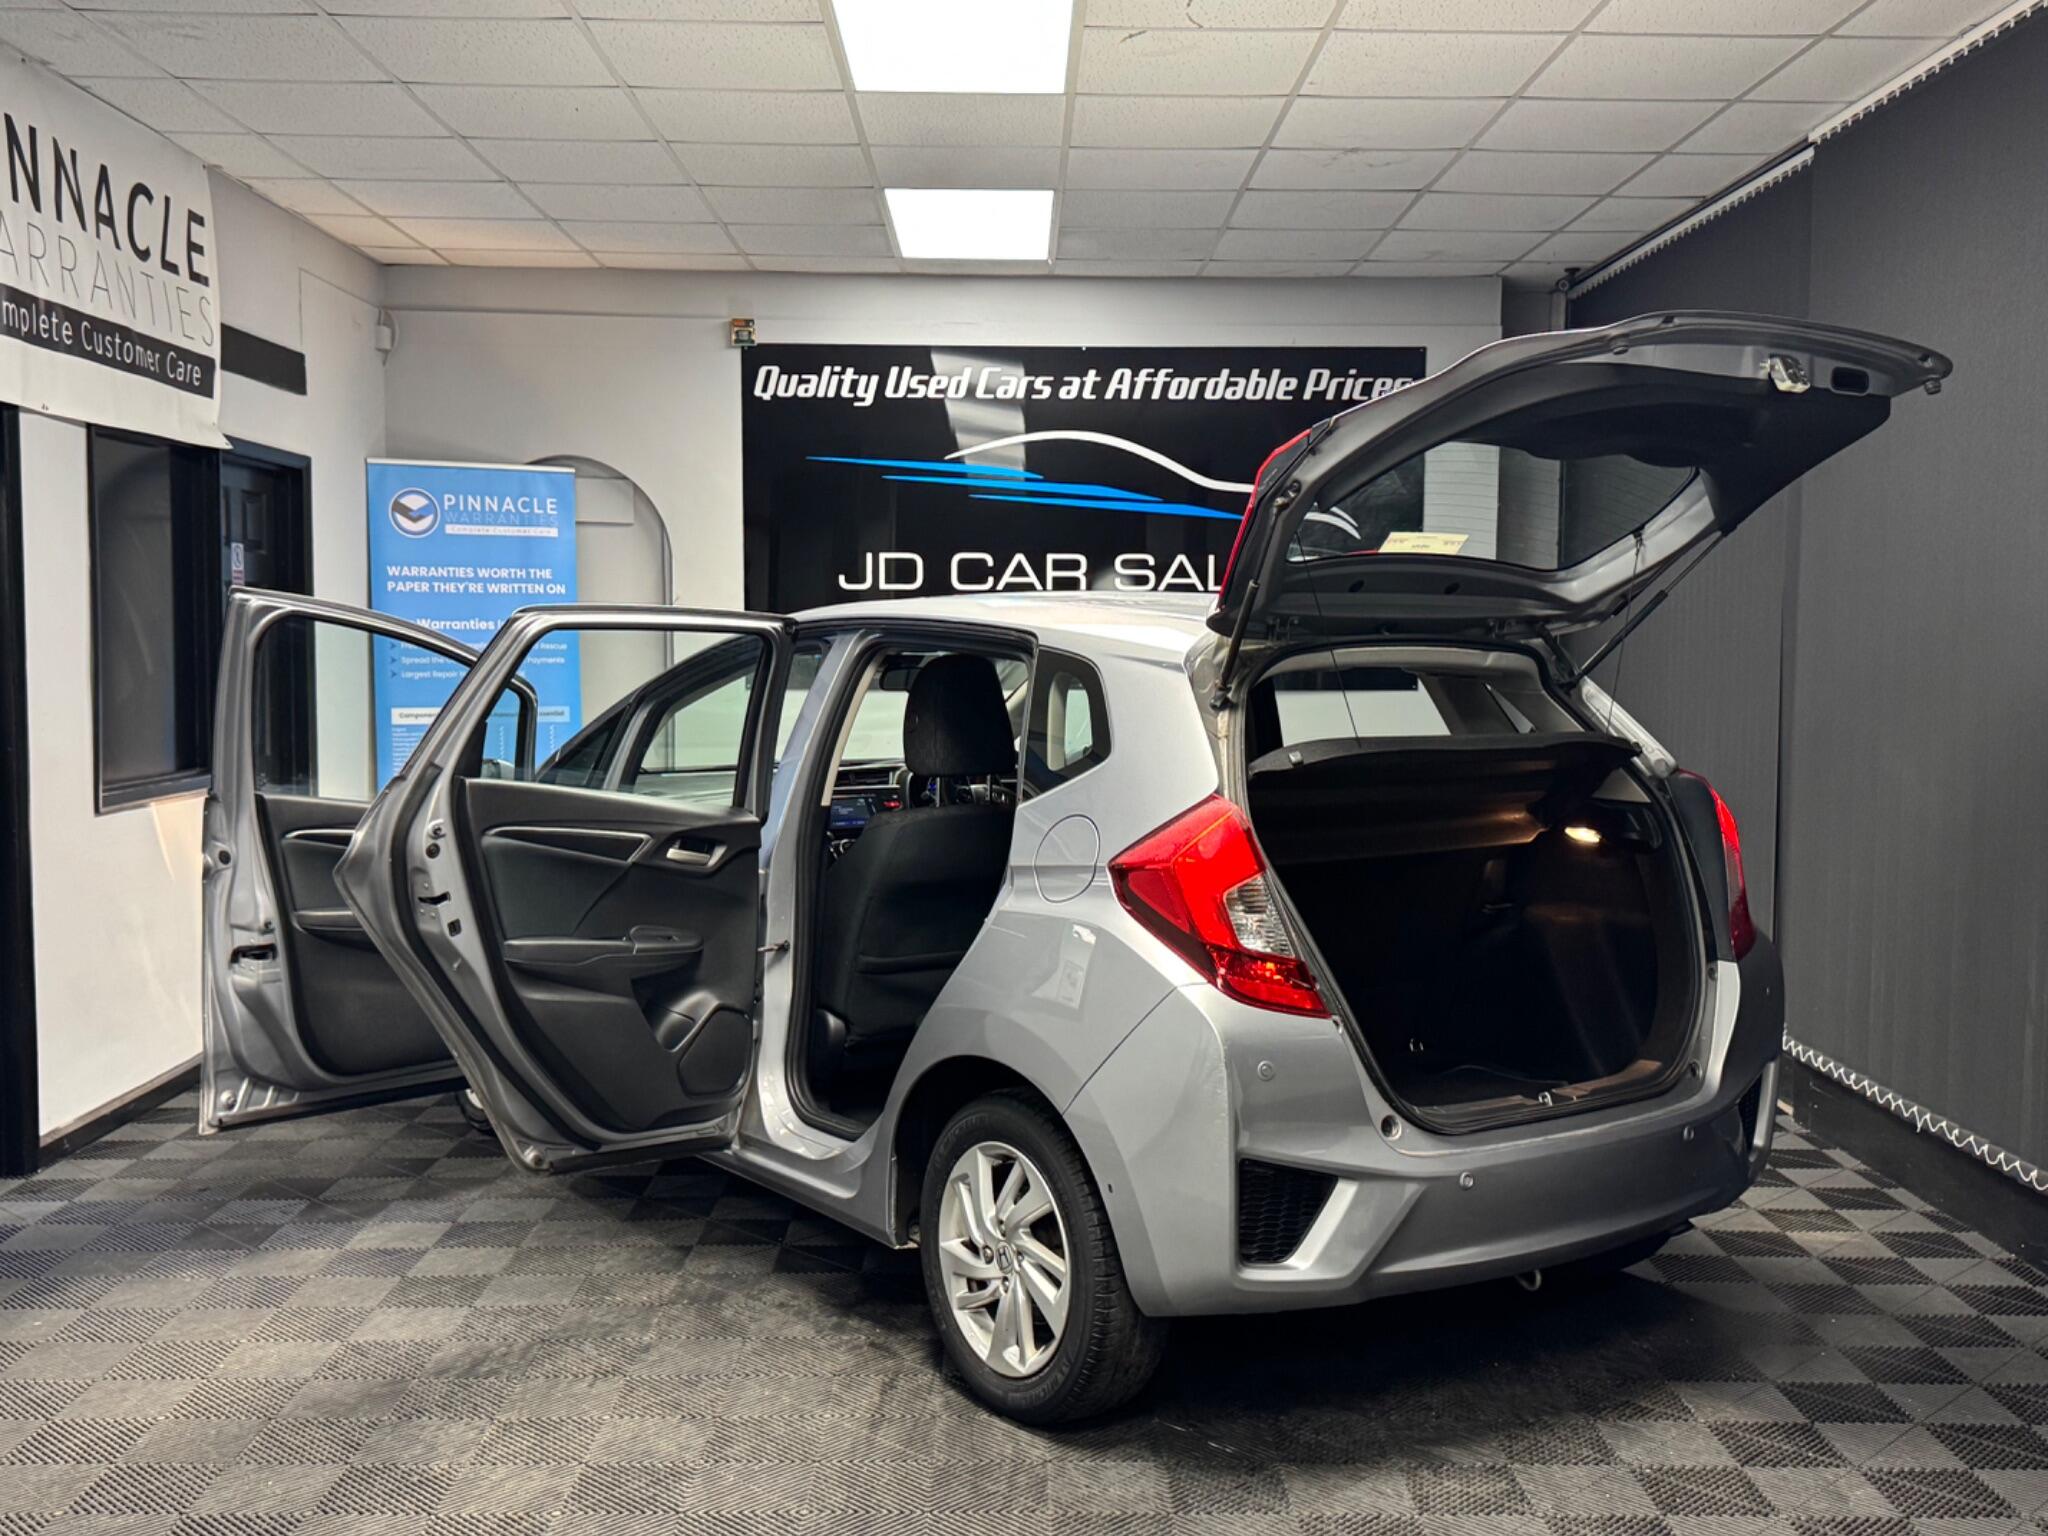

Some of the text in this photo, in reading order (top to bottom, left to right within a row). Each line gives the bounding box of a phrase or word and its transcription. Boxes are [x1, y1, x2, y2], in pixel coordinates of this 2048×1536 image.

[81, 321, 161, 373] Customer
[166, 351, 202, 386] Care
[753, 365, 879, 407] Quality
[884, 366, 972, 399] Used
[974, 366, 1054, 400] Cars
[1058, 369, 1101, 400] at
[1104, 368, 1298, 400] Affordable
[444, 494, 558, 514] PINNACLE
[445, 512, 558, 525] WARRANTIES
[386, 565, 553, 580] WARRANTIES WORTH THE
[838, 552, 924, 590] JD
[950, 552, 1087, 591] CAR
[386, 581, 566, 595] PAPER THEY'RE WRITTEN ON
